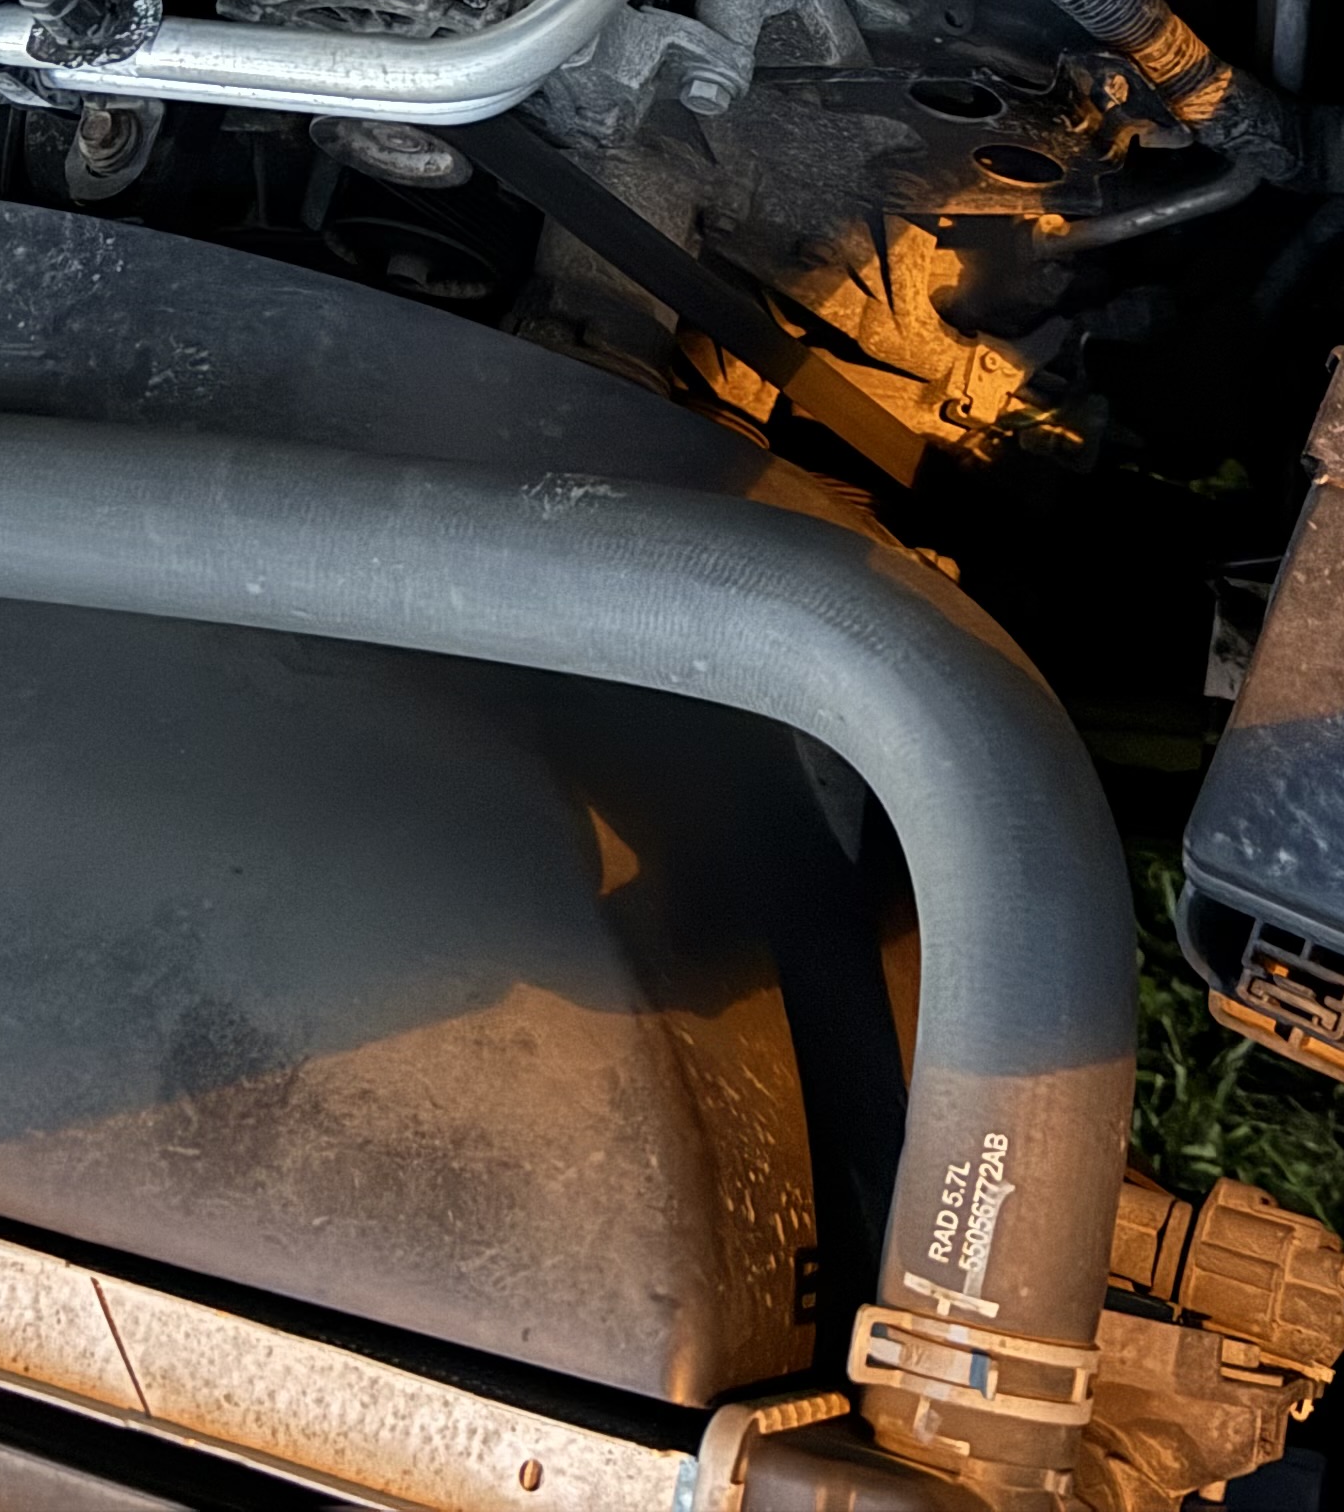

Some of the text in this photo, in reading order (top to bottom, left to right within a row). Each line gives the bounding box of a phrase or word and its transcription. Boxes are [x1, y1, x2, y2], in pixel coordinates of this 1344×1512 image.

[928, 1161, 971, 1264] RAD 5.7L
[959, 1133, 1009, 1272] 55056772AB
